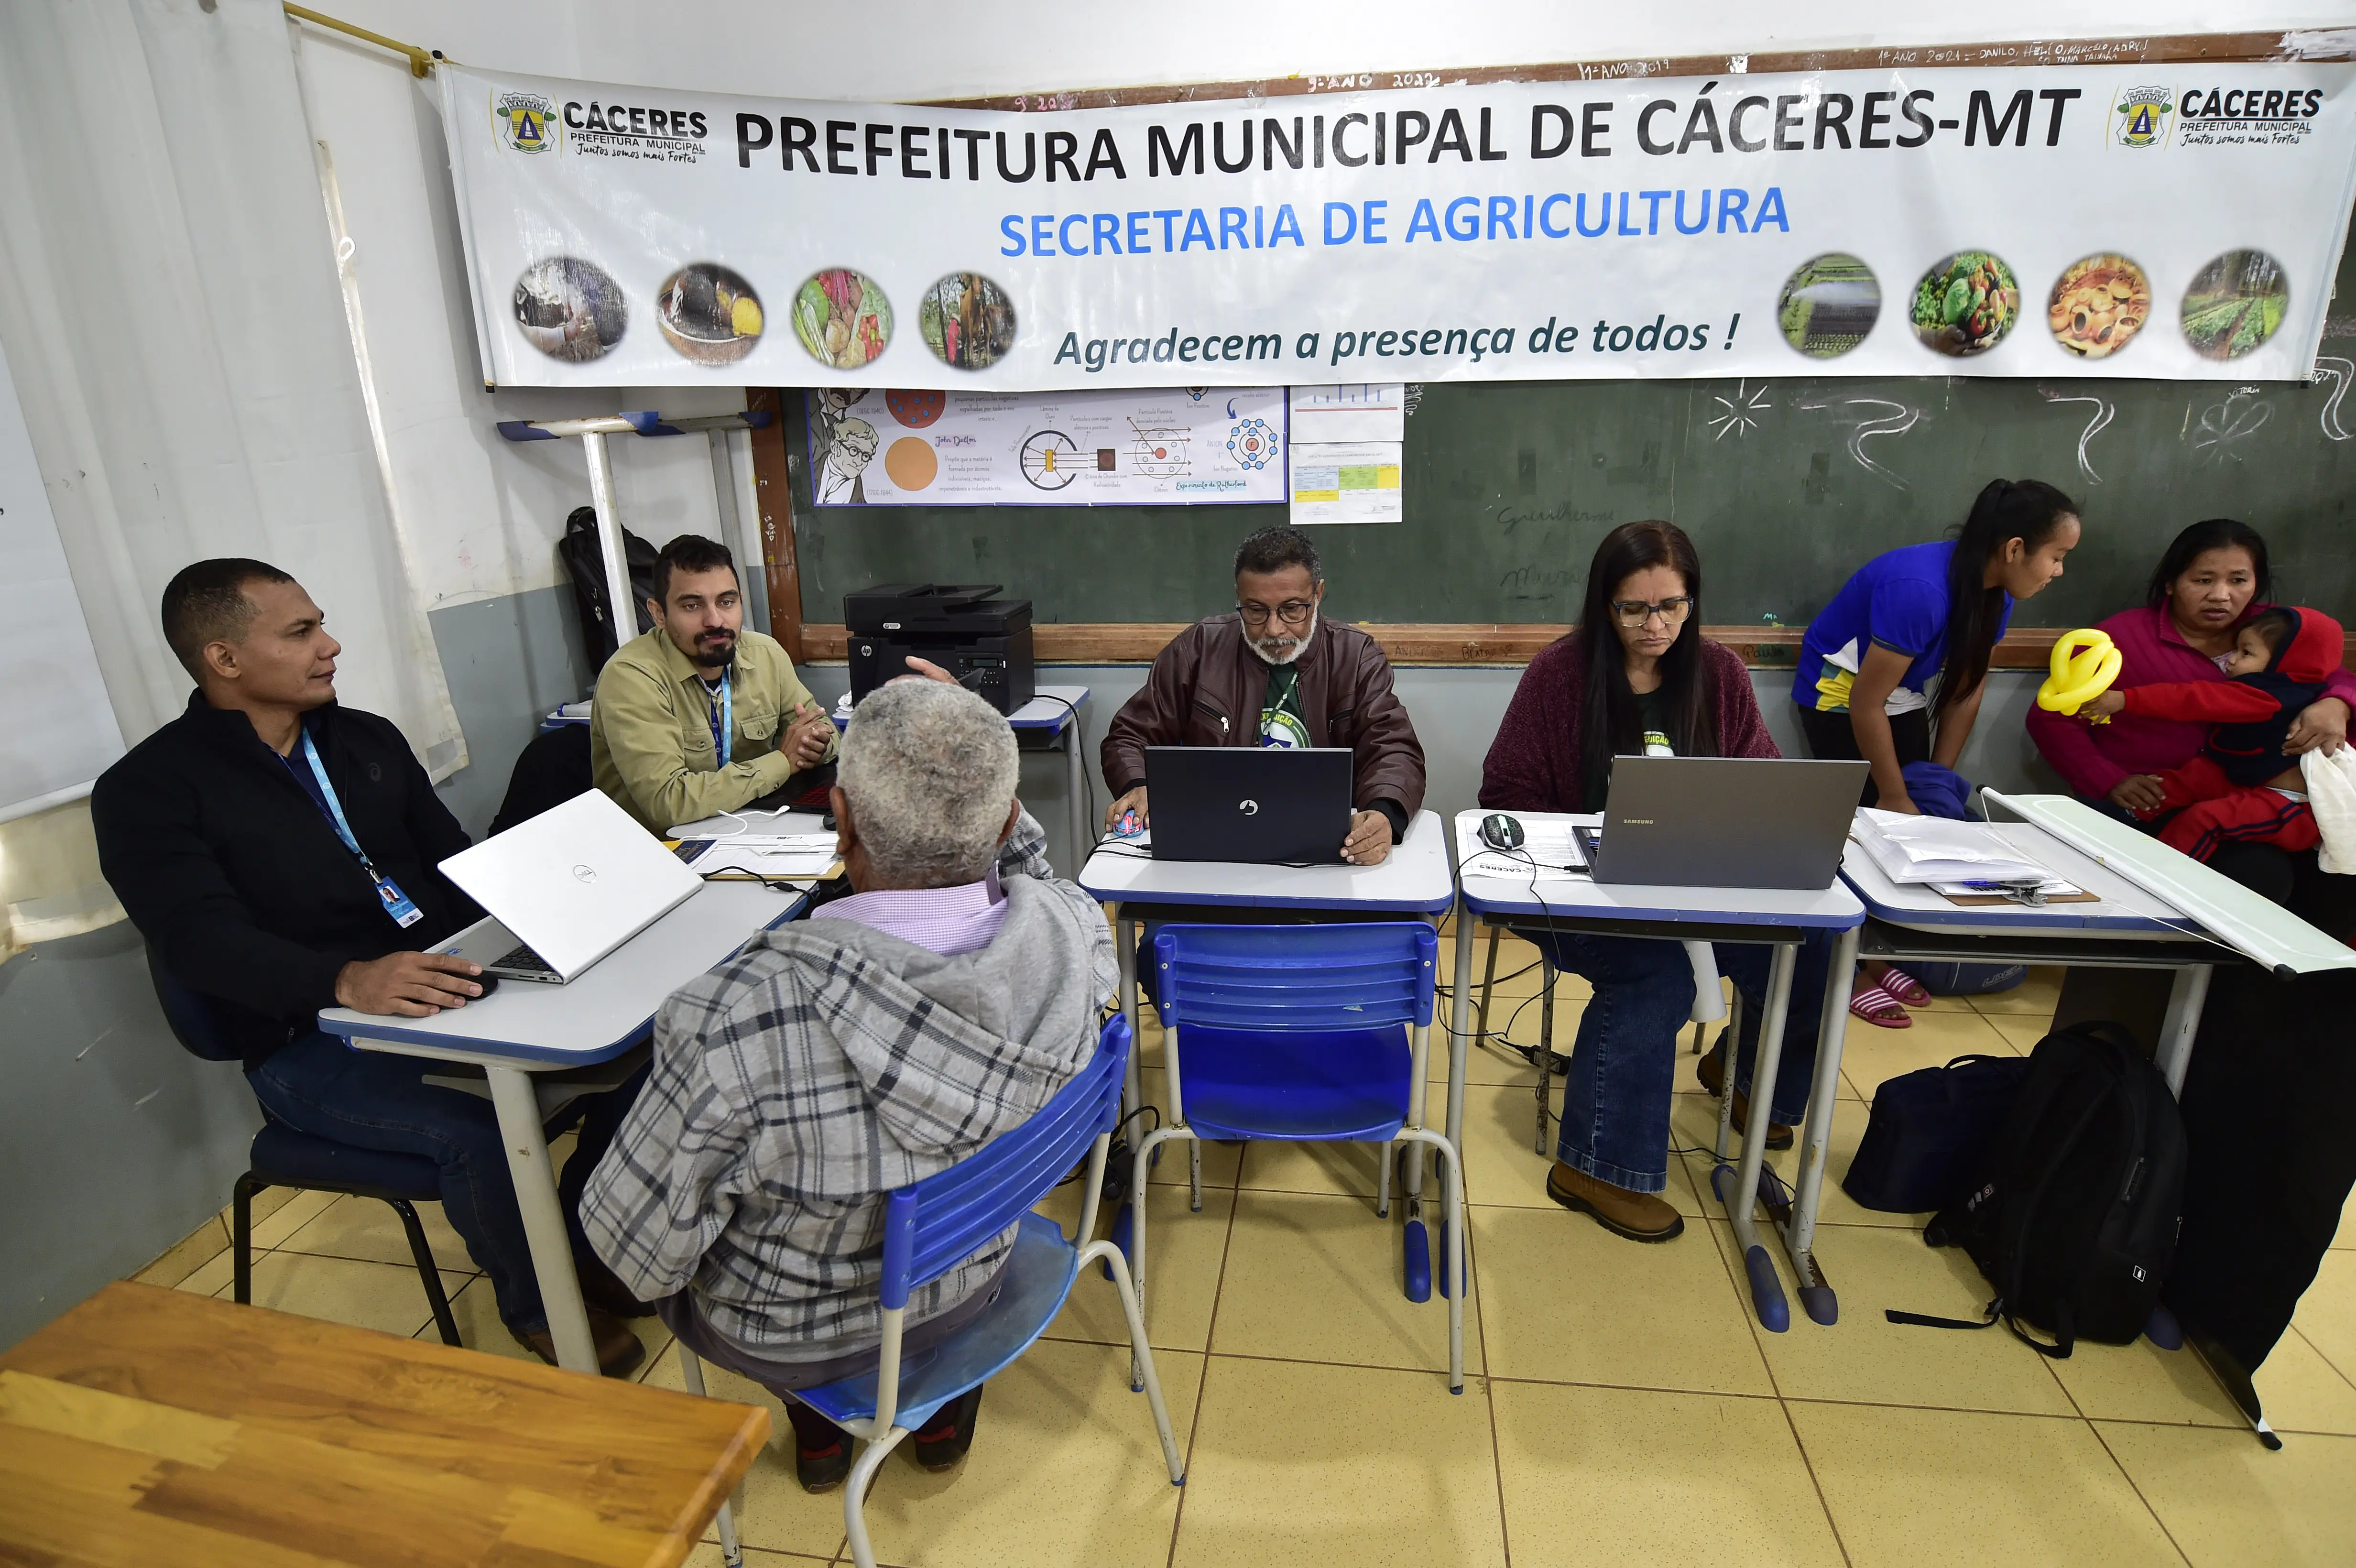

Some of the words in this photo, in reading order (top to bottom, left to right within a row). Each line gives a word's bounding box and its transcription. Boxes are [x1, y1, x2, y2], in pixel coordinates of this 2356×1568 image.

[1891, 50, 1917, 64] ANO
[1926, 50, 1960, 63] 2021
[1602, 62, 1626, 79] ANO
[1327, 74, 1372, 89] ANO
[2180, 87, 2323, 118] CÁCERES
[564, 101, 708, 139] CÁCERES
[2180, 122, 2248, 132] PREFEITURA
[2254, 122, 2312, 131] MUNICIPAL
[736, 113, 1127, 183] PREFEITURA
[1148, 111, 1506, 177] MUNICIPAL
[1531, 102, 1613, 159] DE
[1637, 81, 2081, 155] CÁCERES-MT
[2180, 133, 2214, 147] Juntos
[2216, 135, 2246, 144] somos
[2248, 134, 2269, 144] mais
[2272, 132, 2301, 144] Fortes
[570, 132, 640, 147] PREFEITURA
[647, 139, 706, 152] MUNICIPAL
[575, 143, 609, 156] Juntos
[612, 149, 640, 159] somos
[643, 151, 665, 162] mais
[668, 151, 697, 163] Fortes
[1001, 205, 1304, 257] SECRETARIA
[1324, 200, 1387, 245] DE
[1405, 185, 1789, 243] AGRICULTURA
[1053, 327, 1282, 373] Agradecem
[1296, 333, 1320, 359] a
[1331, 328, 1516, 366] presença
[1528, 317, 1579, 353] de
[1593, 315, 1710, 352] todos
[935, 436, 951, 447] John
[953, 436, 976, 446] Dalton
[1176, 480, 1208, 490] Experimento
[1216, 480, 1247, 492] Rutherford
[862, 645, 872, 656] hp
